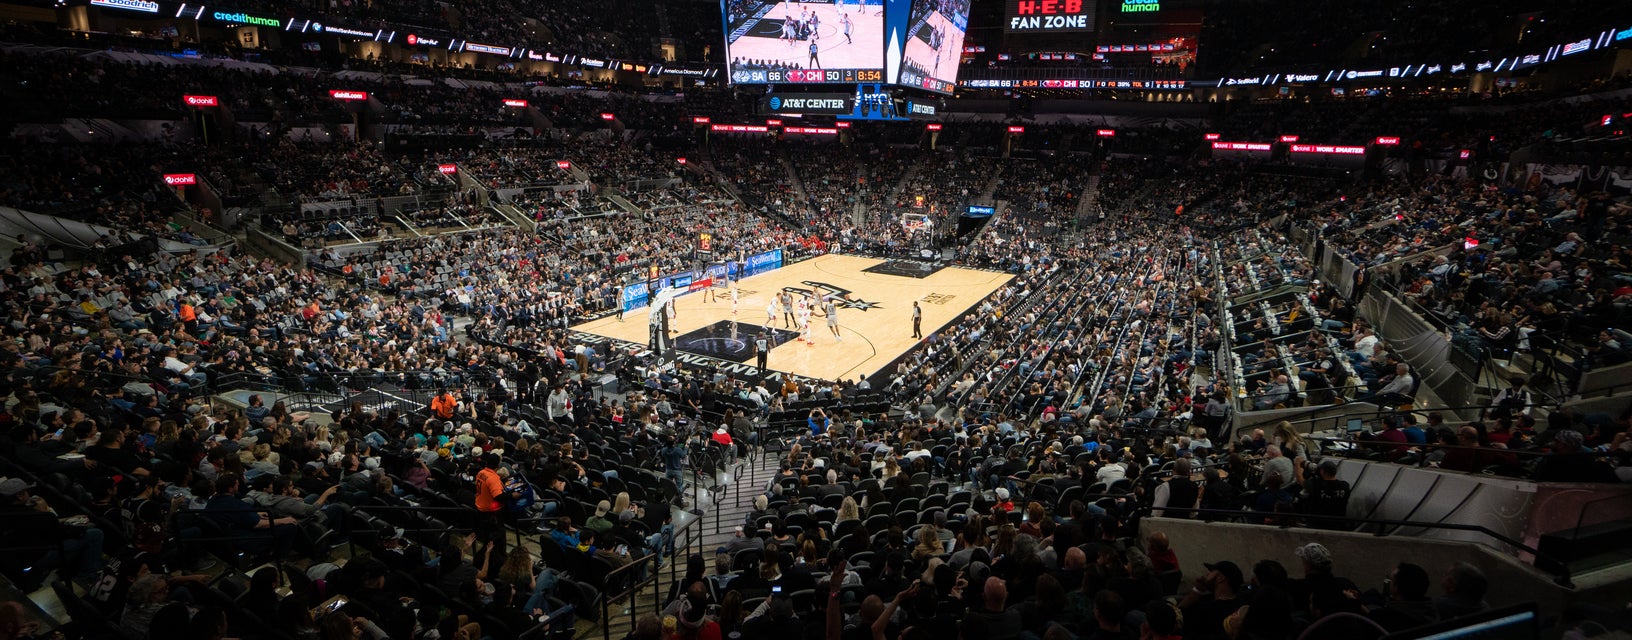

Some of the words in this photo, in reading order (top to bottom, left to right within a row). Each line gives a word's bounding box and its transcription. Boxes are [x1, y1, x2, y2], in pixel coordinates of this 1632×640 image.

[1019, 0, 1082, 14] H-E-B
[1121, 3, 1160, 12] human
[214, 11, 280, 27] credithuman
[1011, 17, 1040, 29] FAN
[1044, 15, 1087, 28] ZONE
[752, 72, 764, 80] SA
[768, 72, 781, 80] 66
[807, 72, 823, 80] CHI
[826, 72, 839, 80] 50
[857, 71, 881, 80] 8:54
[1296, 73, 1318, 82] Valero
[1079, 80, 1090, 88] 50
[783, 98, 804, 108] AT&T
[808, 98, 844, 109] CENTER
[922, 104, 935, 114] CENTER
[175, 175, 193, 183] dahill
[702, 240, 710, 249] 15
[752, 251, 775, 267] SeaWorld
